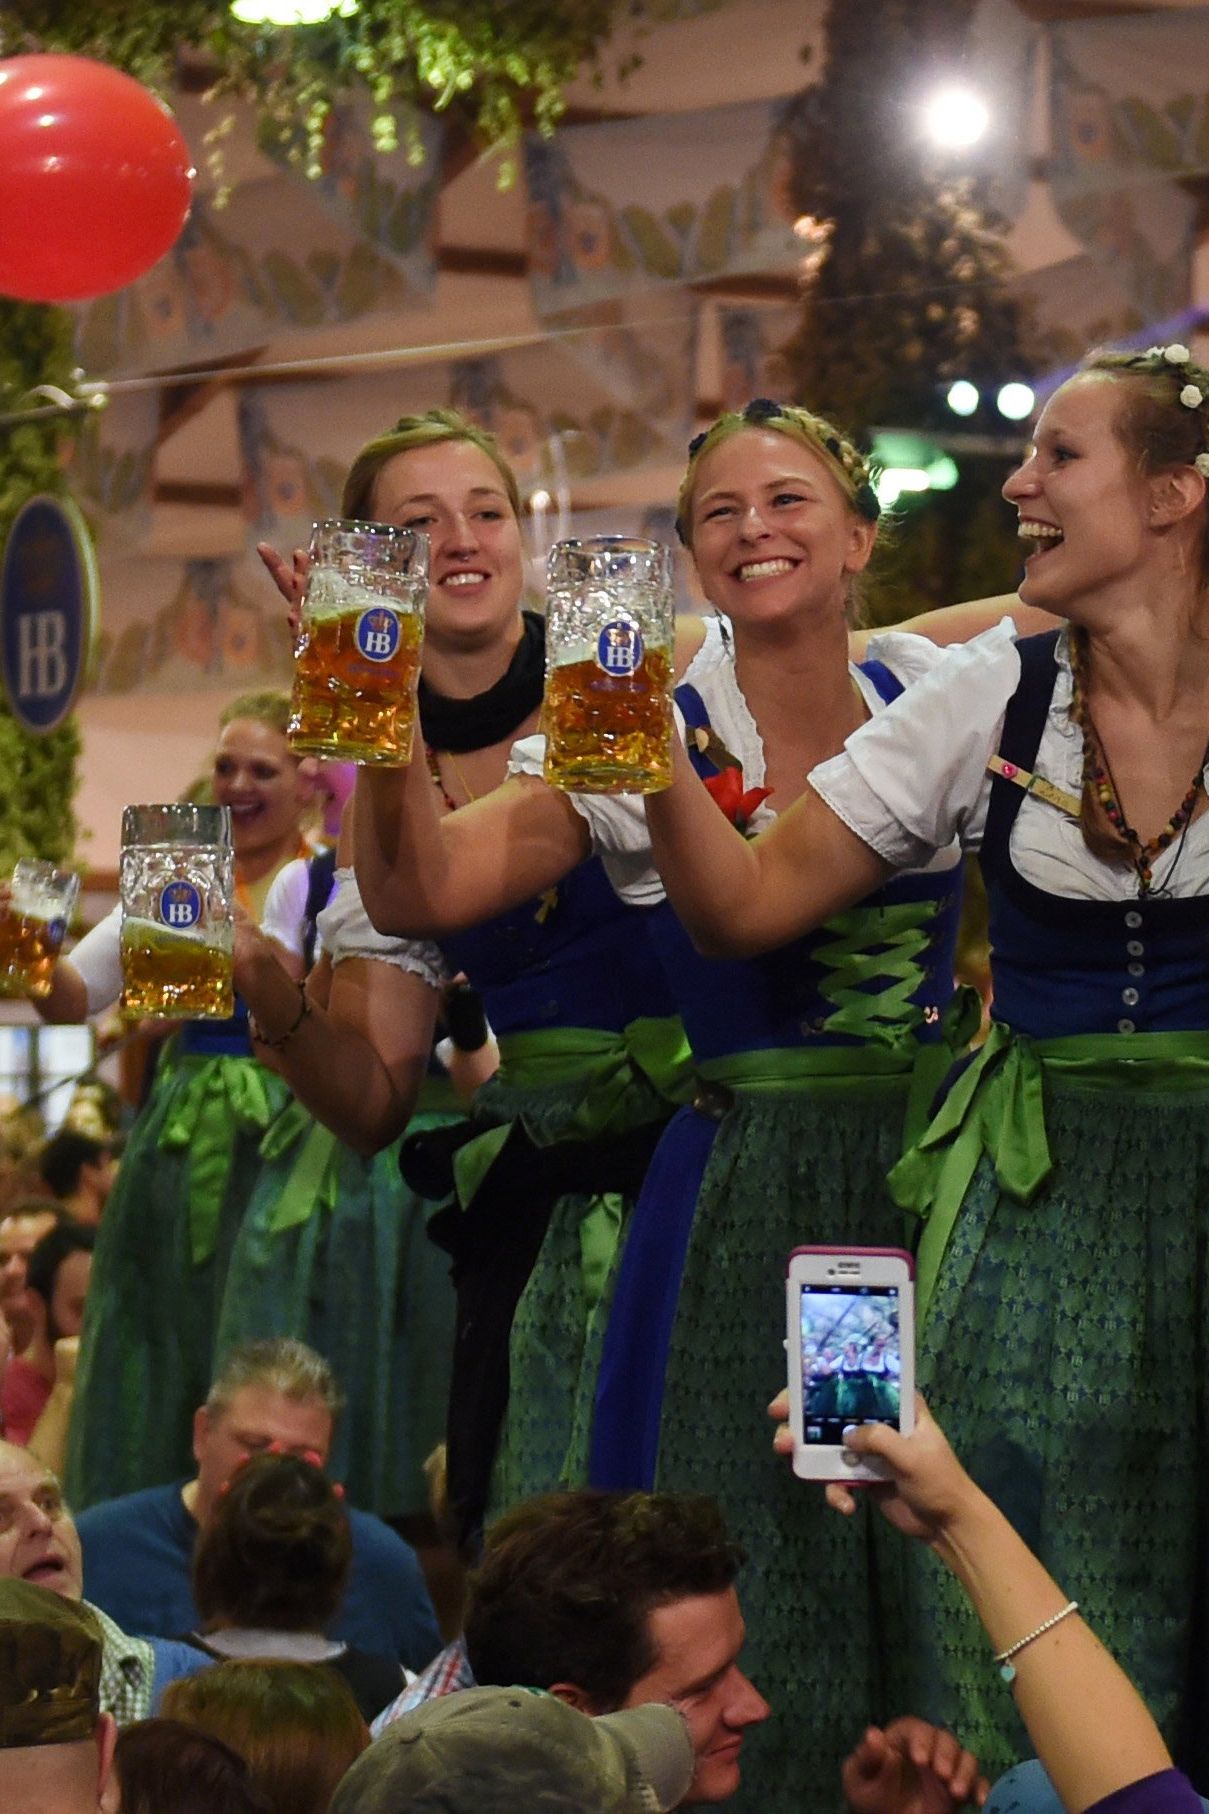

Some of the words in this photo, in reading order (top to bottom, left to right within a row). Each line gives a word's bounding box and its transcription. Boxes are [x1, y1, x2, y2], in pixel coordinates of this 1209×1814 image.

[365, 631, 391, 654] HB
[18, 611, 67, 697] HB
[606, 646, 634, 668] HB
[169, 903, 193, 923] HB
